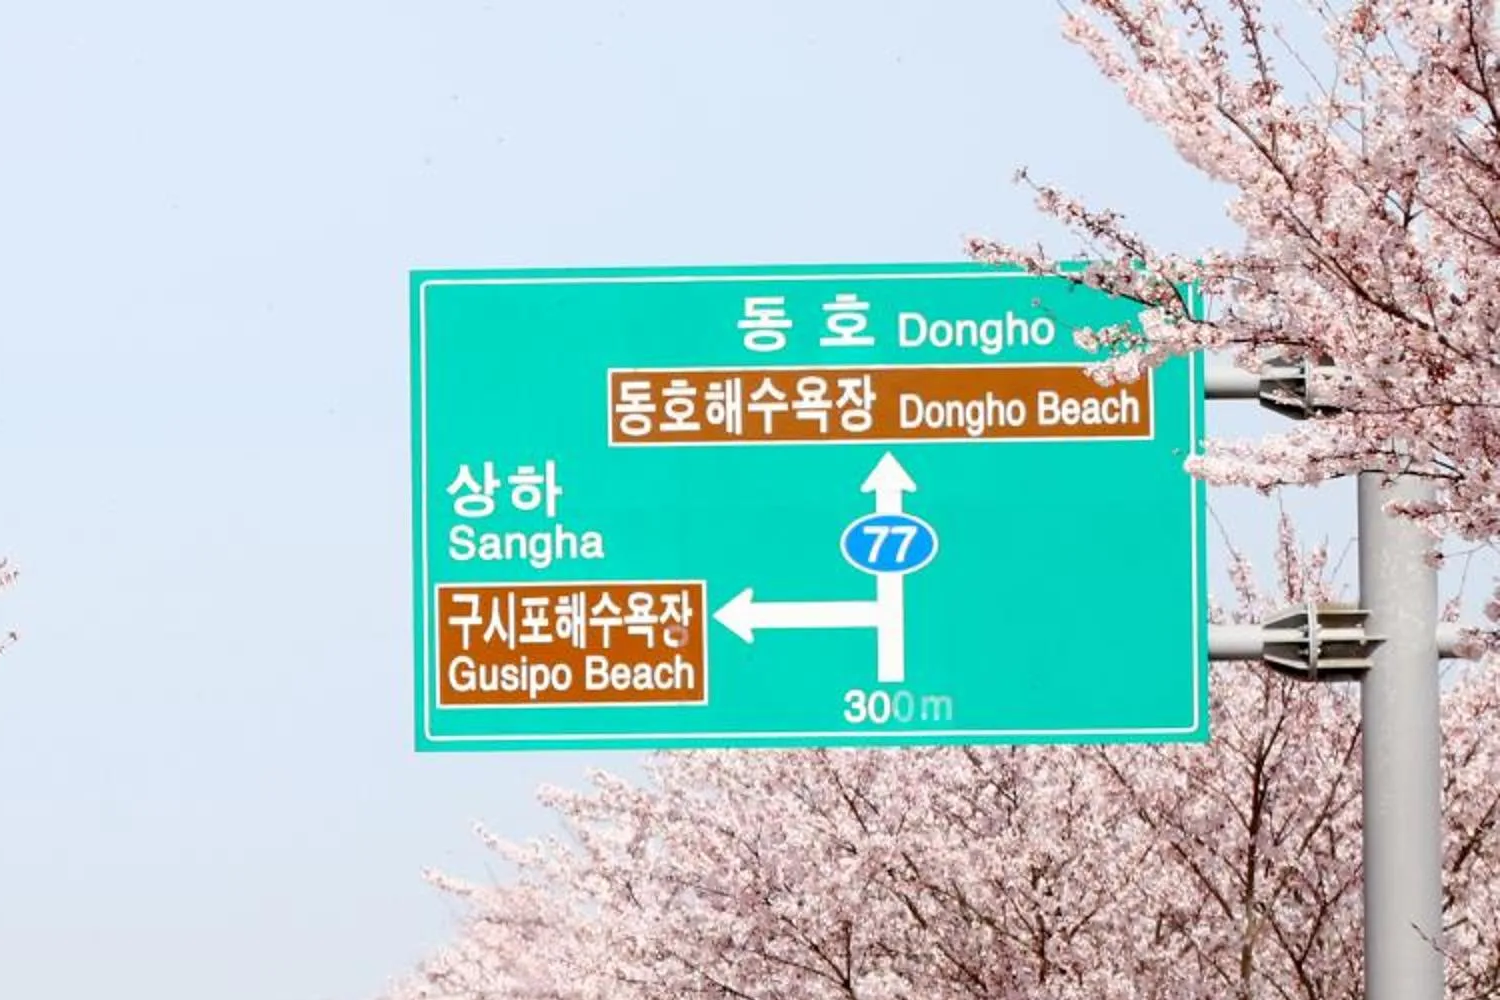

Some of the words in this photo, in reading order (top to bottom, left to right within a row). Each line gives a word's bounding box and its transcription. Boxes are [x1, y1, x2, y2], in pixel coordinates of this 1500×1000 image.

[898, 312, 1056, 356] Dongho
[615, 375, 877, 436] 동호해수욕장
[899, 392, 1028, 435] Dongho
[1037, 388, 1141, 427] Beach
[447, 460, 565, 519] 상하
[448, 524, 606, 570] Sangha
[861, 525, 919, 563] 77
[448, 590, 693, 651] 구시포해수욕장
[448, 655, 573, 699] Gusipo
[585, 654, 696, 691] Beach
